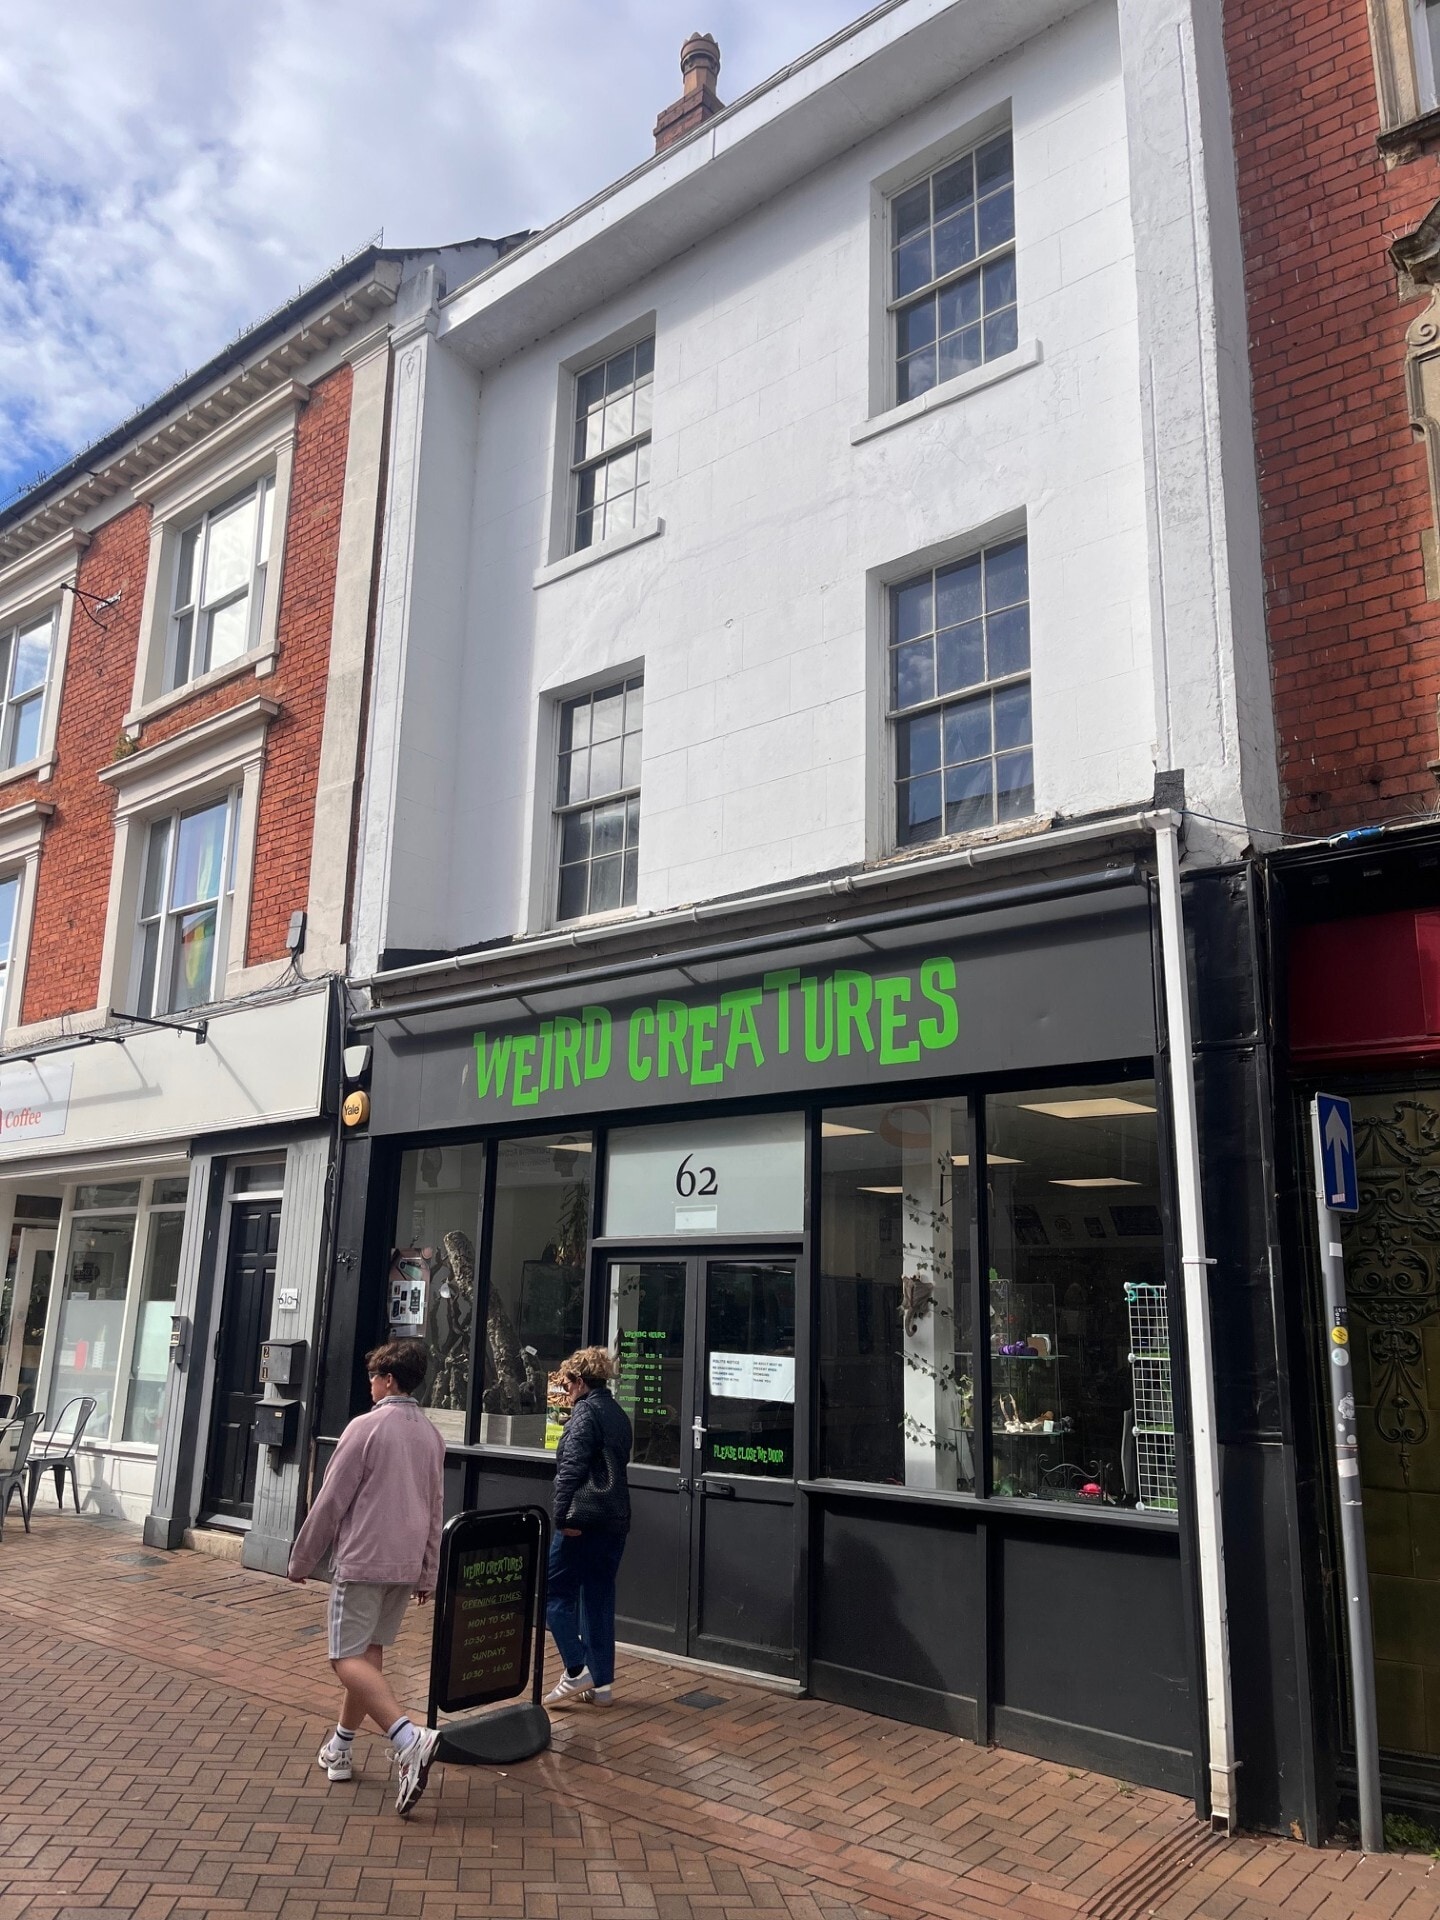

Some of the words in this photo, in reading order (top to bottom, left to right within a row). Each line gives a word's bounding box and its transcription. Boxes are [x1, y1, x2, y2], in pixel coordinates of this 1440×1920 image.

[473, 1005, 613, 1107] WEIRD
[628, 955, 960, 1086] CREATURES
[5, 1107, 42, 1129] Coffee
[344, 1104, 360, 1116] Yale
[676, 1153, 718, 1197] 62
[713, 1444, 737, 1461] PLEASE
[738, 1446, 758, 1463] CLOSE
[767, 1447, 784, 1463] DOOR
[463, 1560, 486, 1580] WEIRD
[486, 1555, 524, 1575] CREATURES
[461, 1594, 497, 1609] OPENING
[467, 1616, 486, 1629] MON
[488, 1615, 499, 1625] TO
[500, 1611, 516, 1623] SAT
[471, 1646, 507, 1662] SUNDAYS
